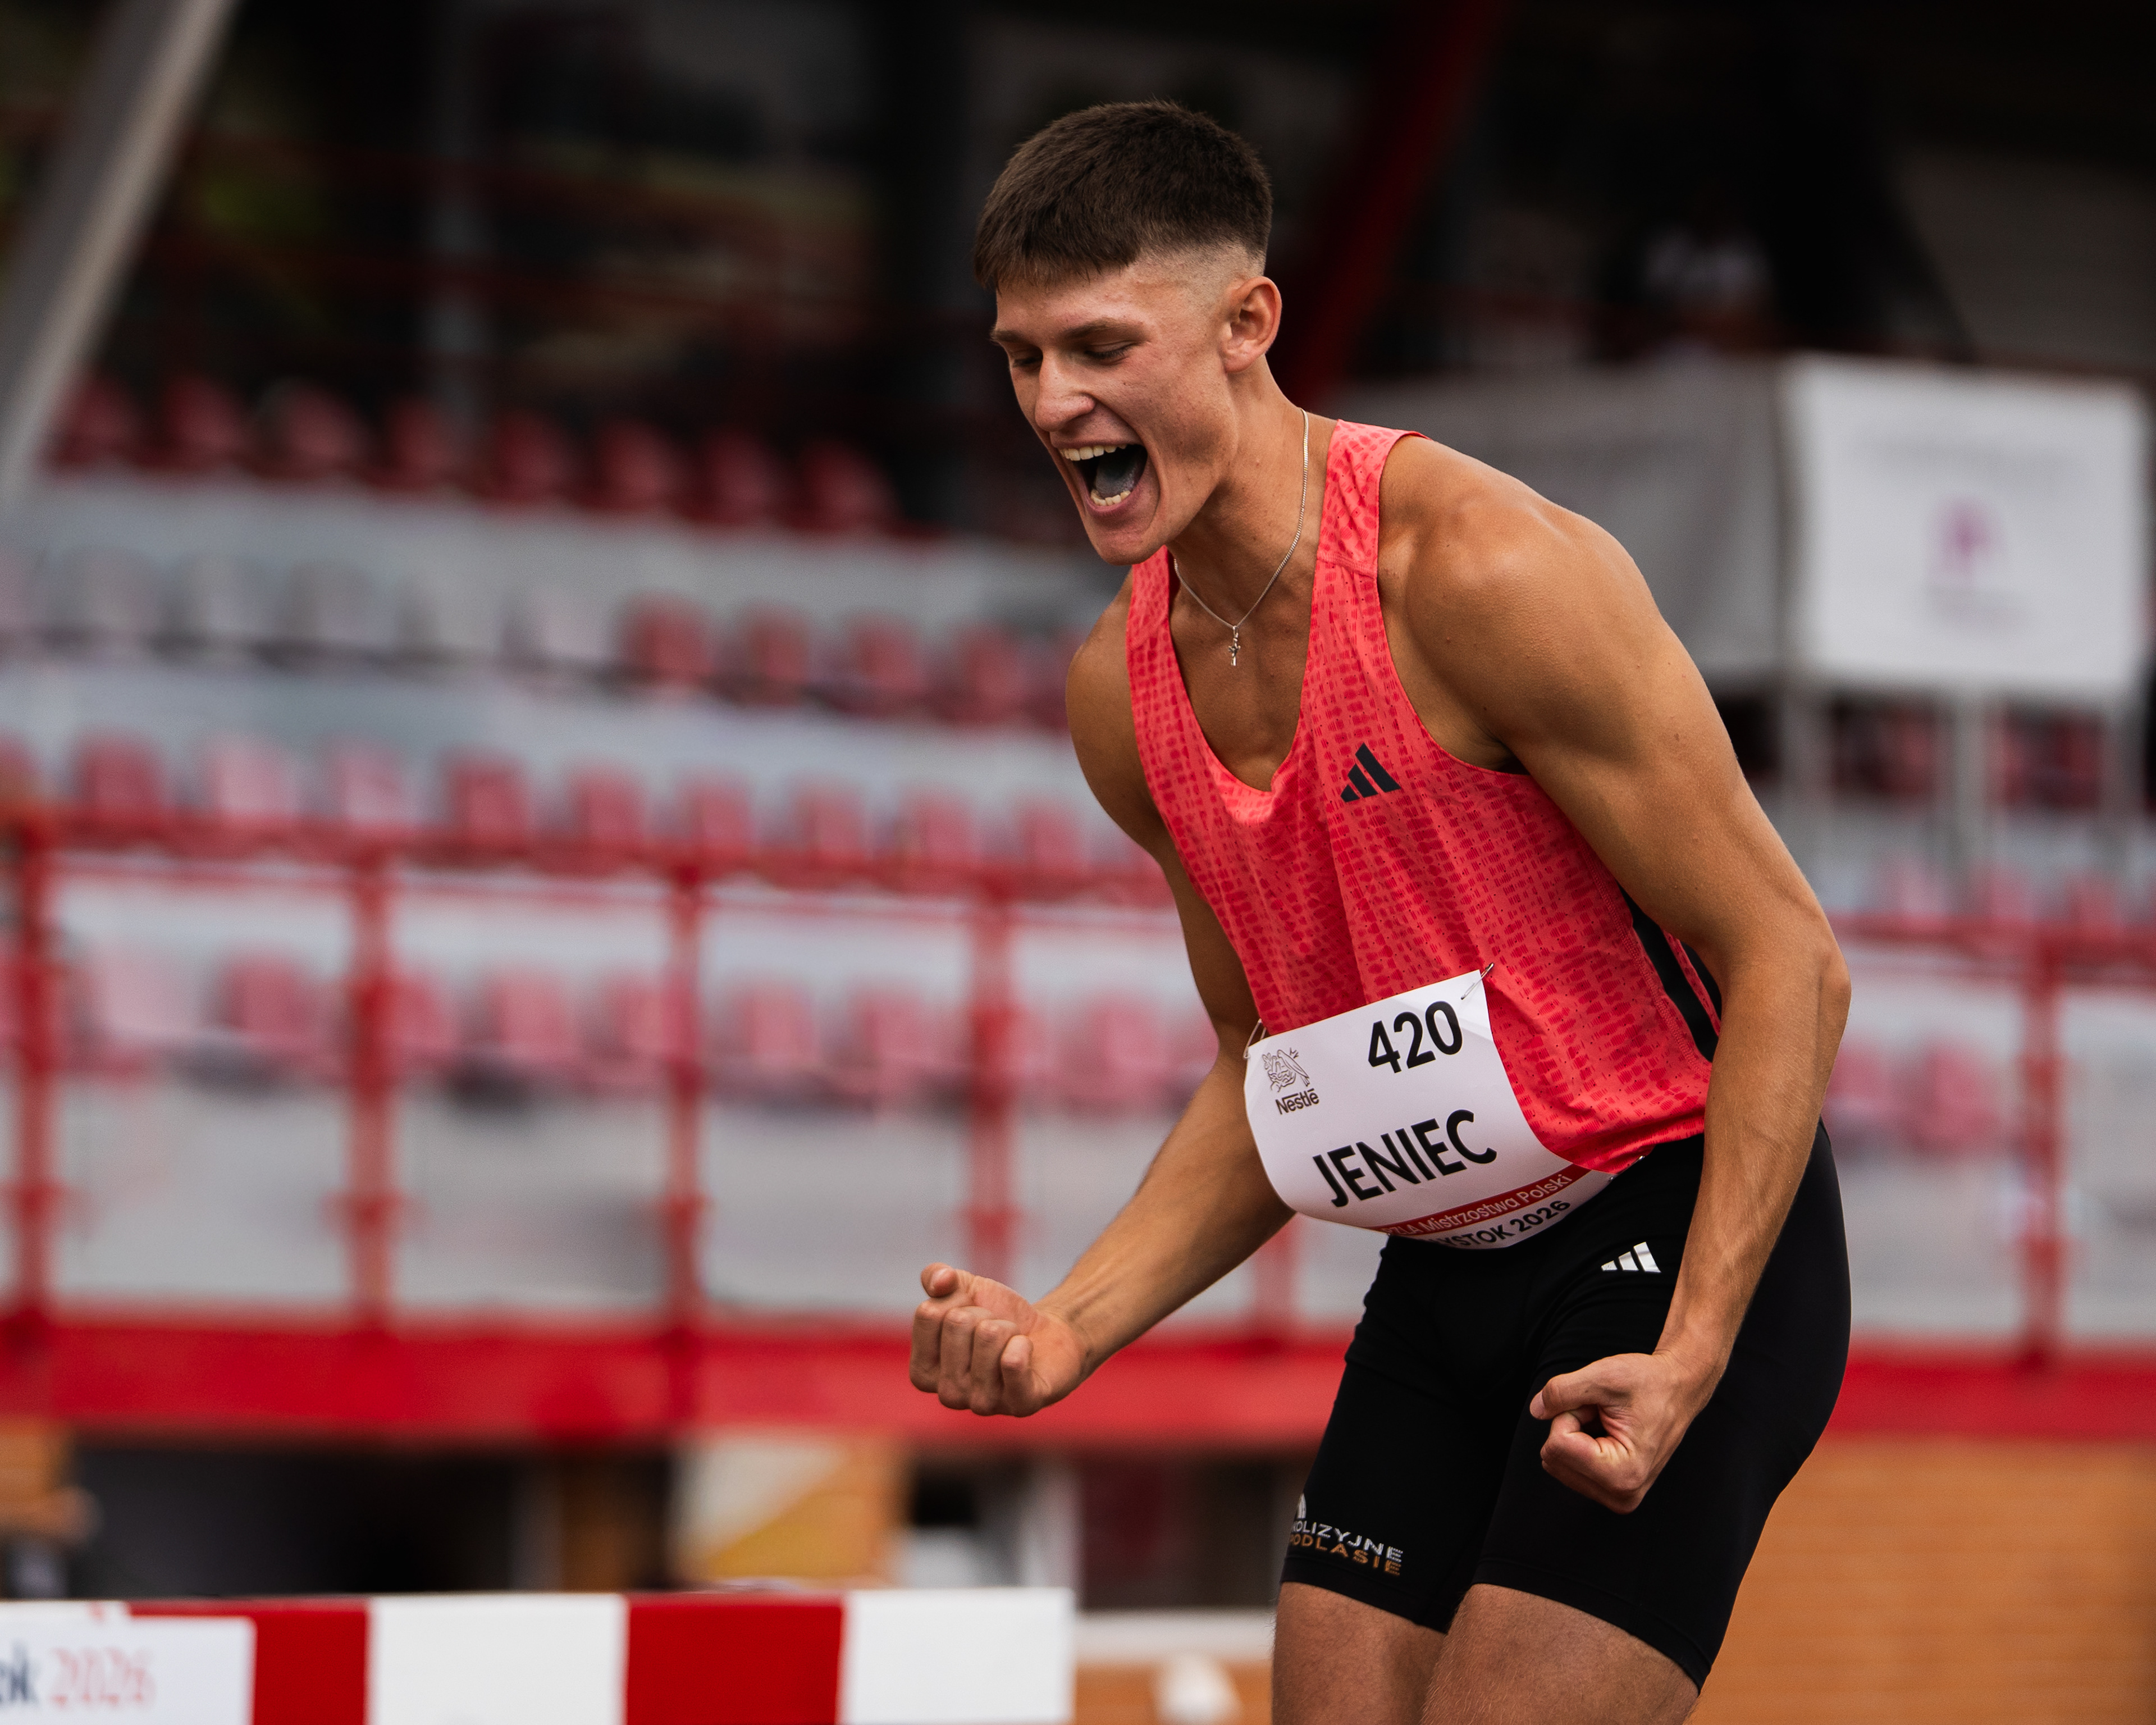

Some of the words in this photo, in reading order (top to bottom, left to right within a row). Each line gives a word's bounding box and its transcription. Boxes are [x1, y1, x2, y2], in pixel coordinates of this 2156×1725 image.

[1368, 1001, 1463, 1073] 420
[1312, 1109, 1497, 1207] JENIEC
[1418, 1197, 1521, 1231] Mistrzostwa
[1516, 1173, 1573, 1204] Polski
[1509, 1199, 1572, 1233] 2026
